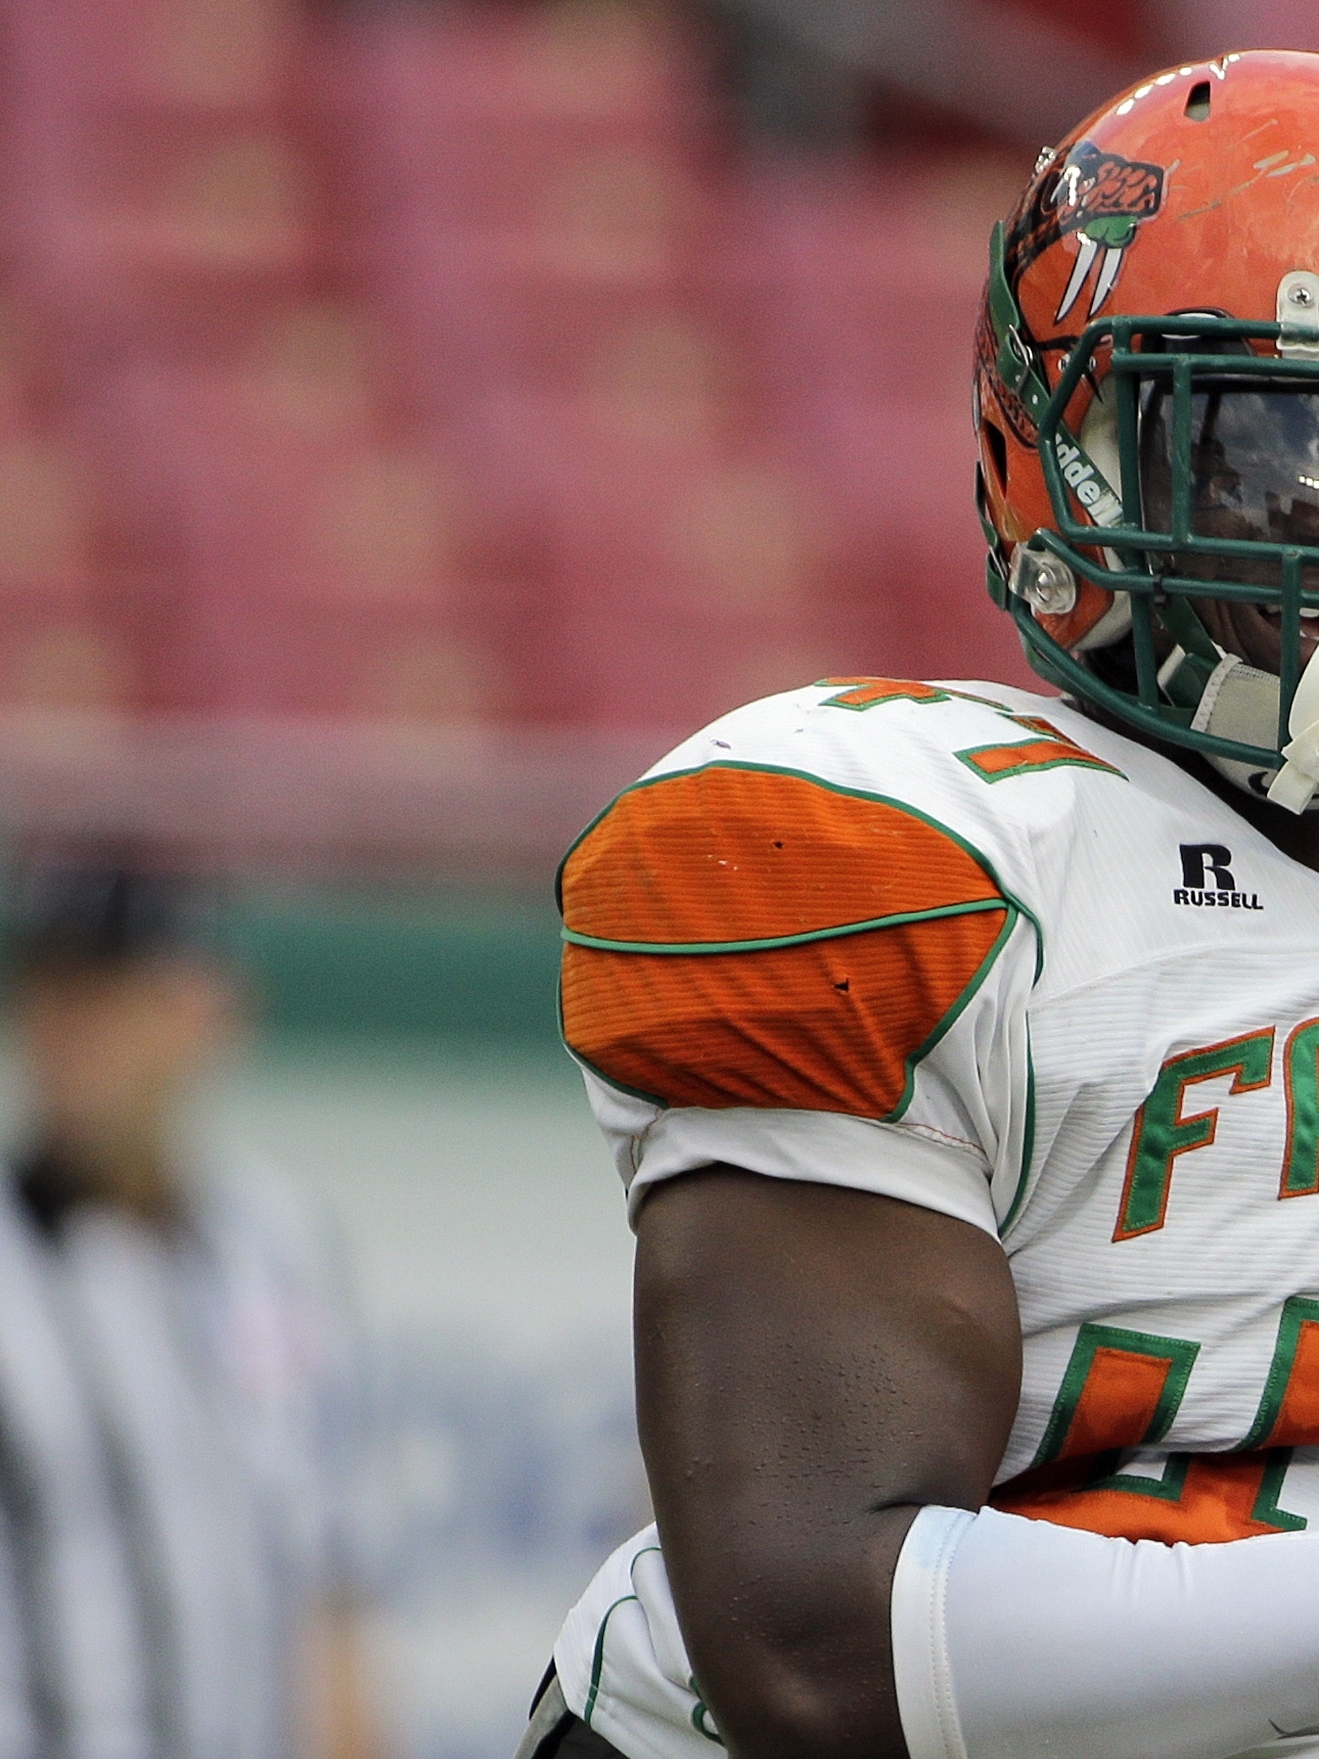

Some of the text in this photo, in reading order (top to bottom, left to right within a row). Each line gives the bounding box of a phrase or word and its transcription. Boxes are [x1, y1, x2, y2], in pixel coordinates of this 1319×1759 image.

[1055, 432, 1124, 528] ddell
[1179, 843, 1236, 891] R
[1173, 888, 1265, 911] RUSSELL
